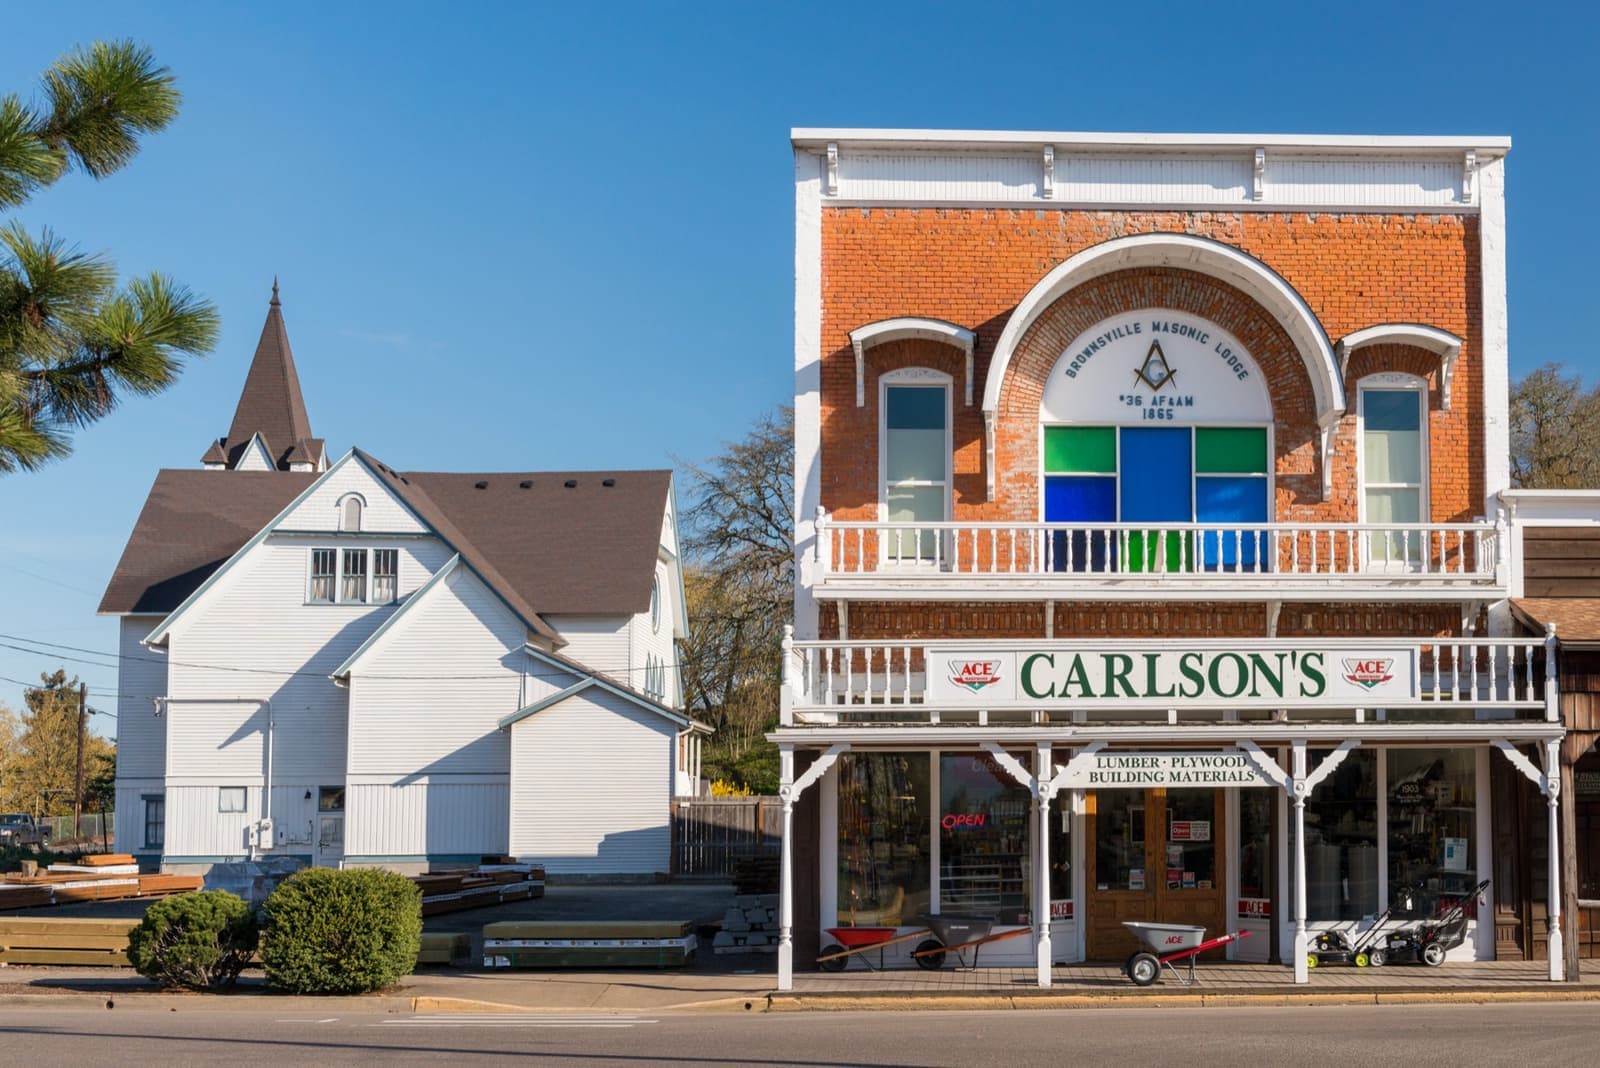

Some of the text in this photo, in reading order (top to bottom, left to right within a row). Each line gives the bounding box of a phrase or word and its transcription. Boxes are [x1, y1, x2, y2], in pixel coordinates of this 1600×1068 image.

[1065, 321, 1249, 381] BROWNSVILLE MASONIC LODGE
[1151, 395, 1194, 407] AF&AM
[1142, 408, 1174, 420] 1865
[961, 661, 993, 676] ACE
[1354, 660, 1385, 674] ACE
[1020, 651, 1327, 698] CARLSON'S
[1097, 756, 1247, 769] LUMBER PLYWOOD
[1089, 769, 1255, 783] BUILDING MATERIALS
[941, 813, 988, 829] OPEN
[1052, 903, 1067, 915] ACE
[1246, 901, 1263, 914] ACE
[1165, 935, 1184, 944] ACE
